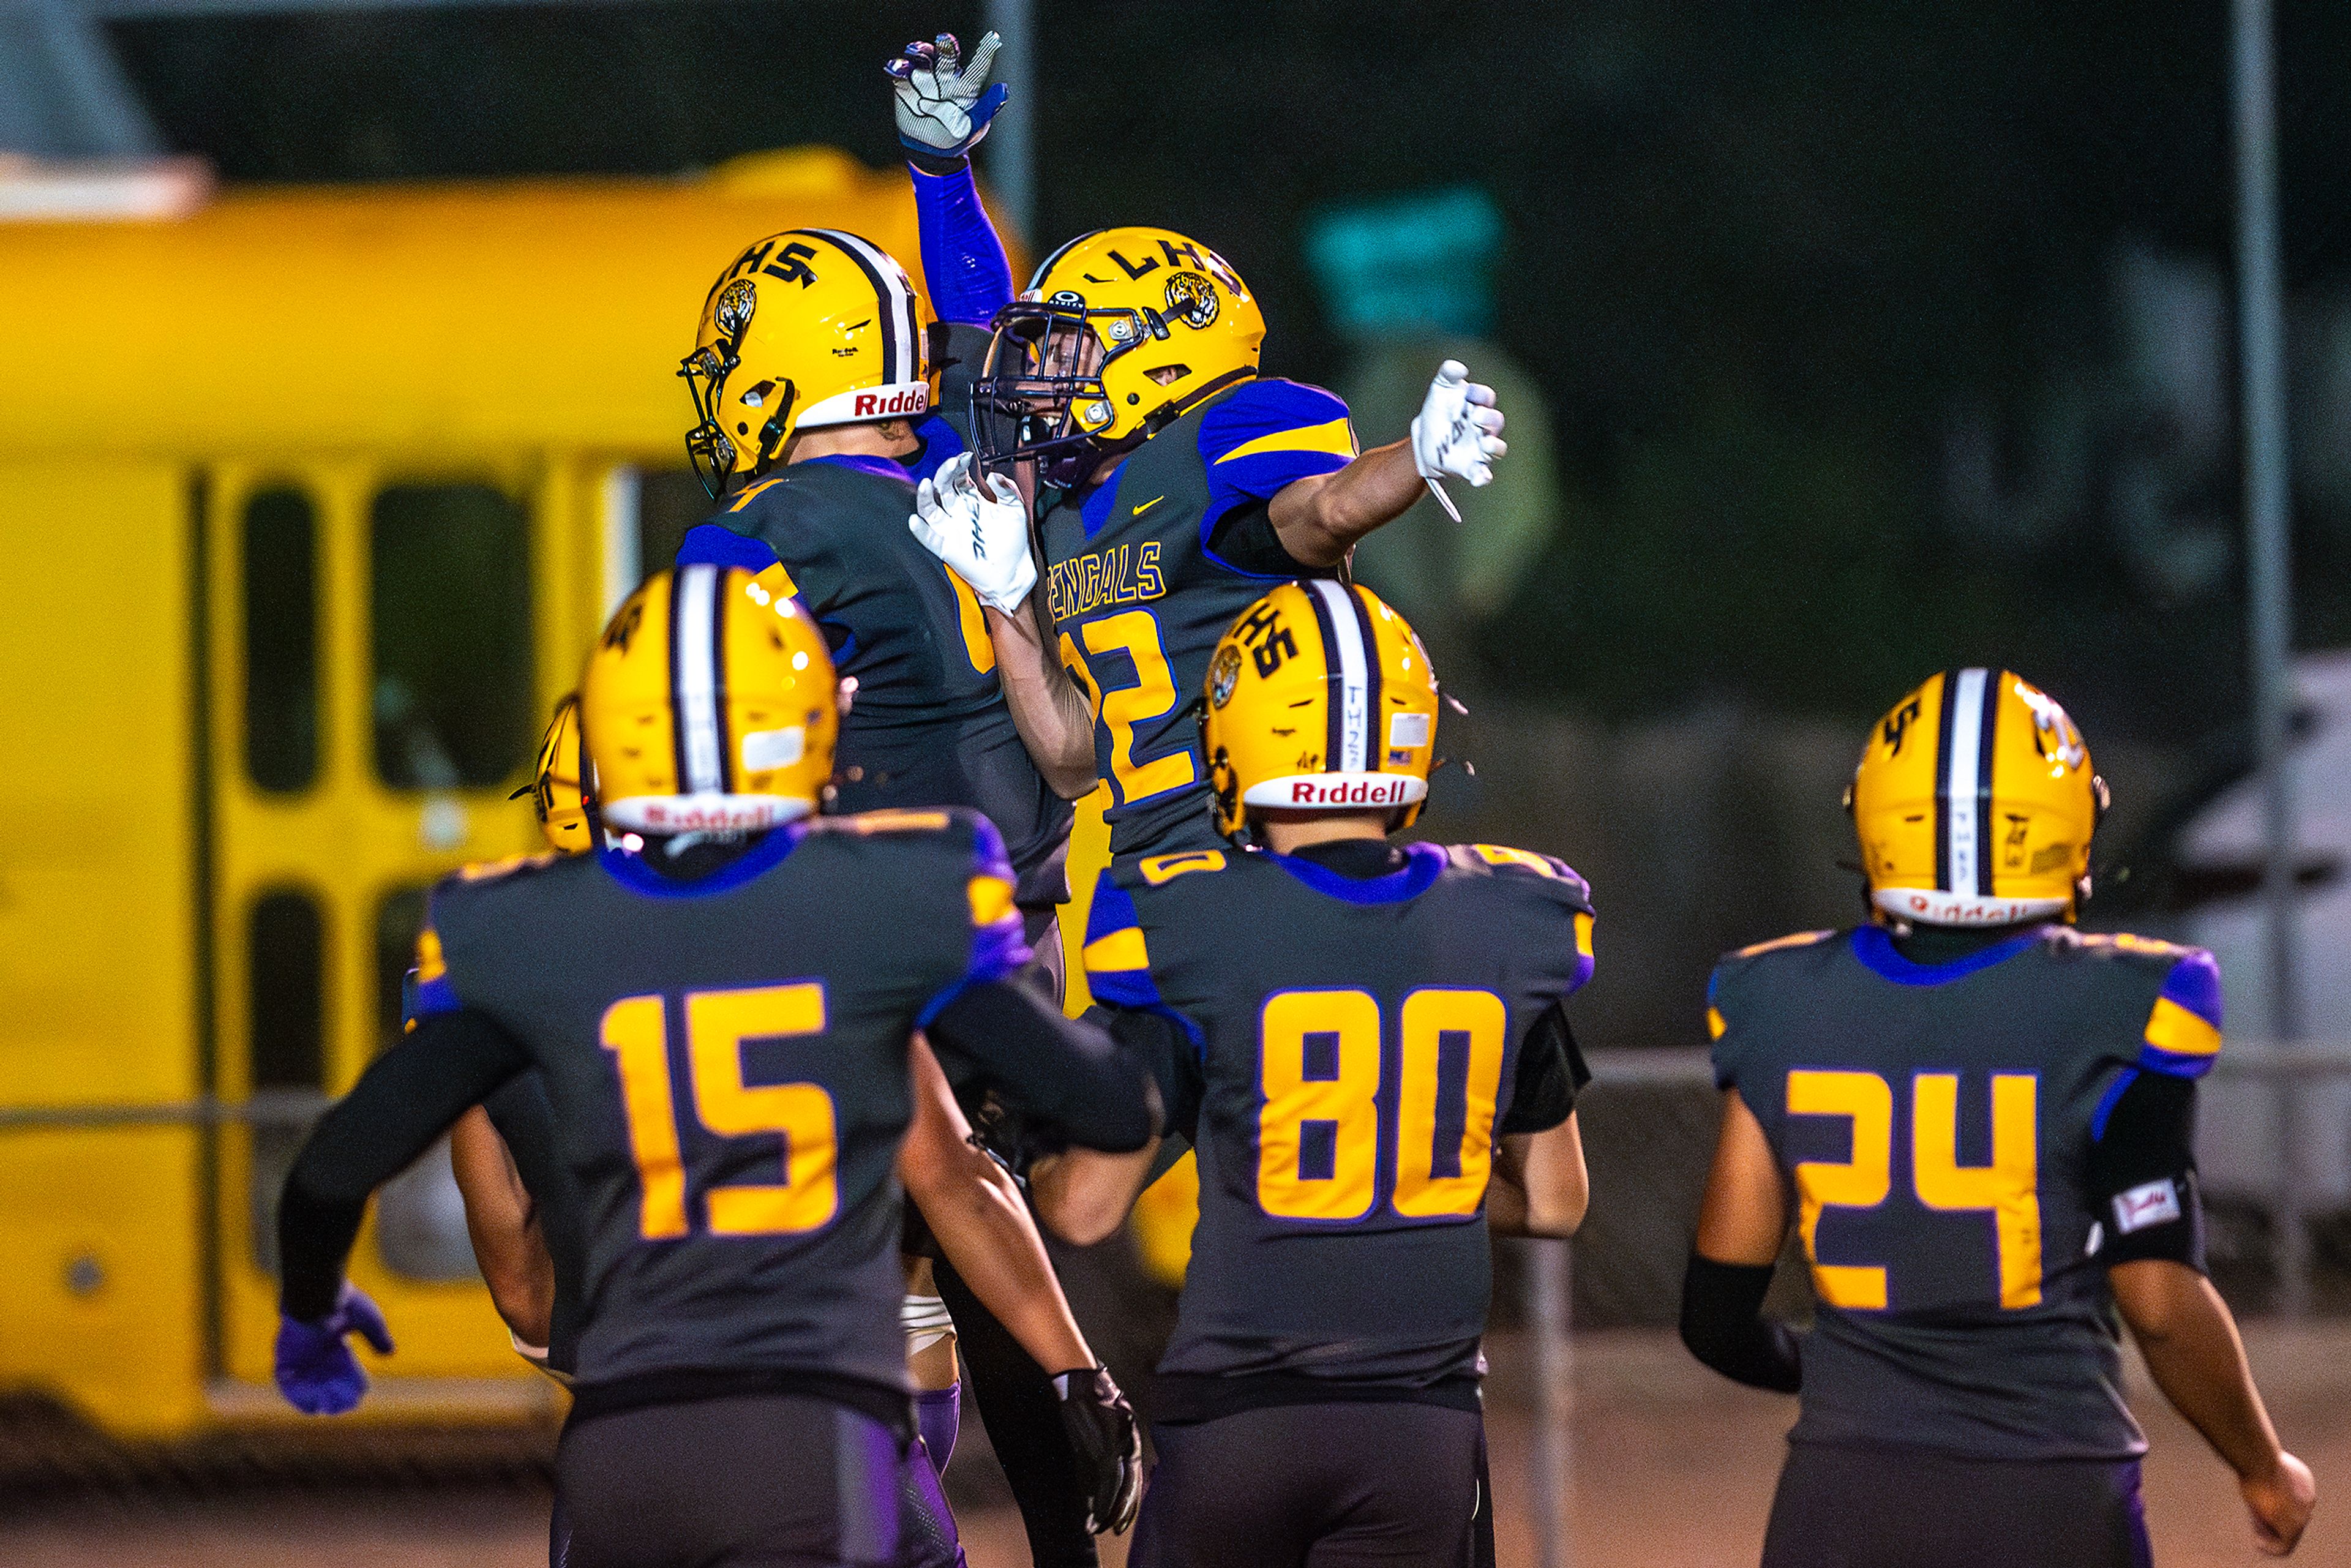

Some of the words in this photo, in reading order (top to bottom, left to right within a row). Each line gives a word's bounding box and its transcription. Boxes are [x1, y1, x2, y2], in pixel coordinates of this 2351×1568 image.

[1048, 541, 1167, 625] ENGALS
[1292, 780, 1406, 803] Riddell
[598, 980, 839, 1241] 15
[1254, 987, 1509, 1221] 80
[1785, 1069, 2044, 1311] 24
